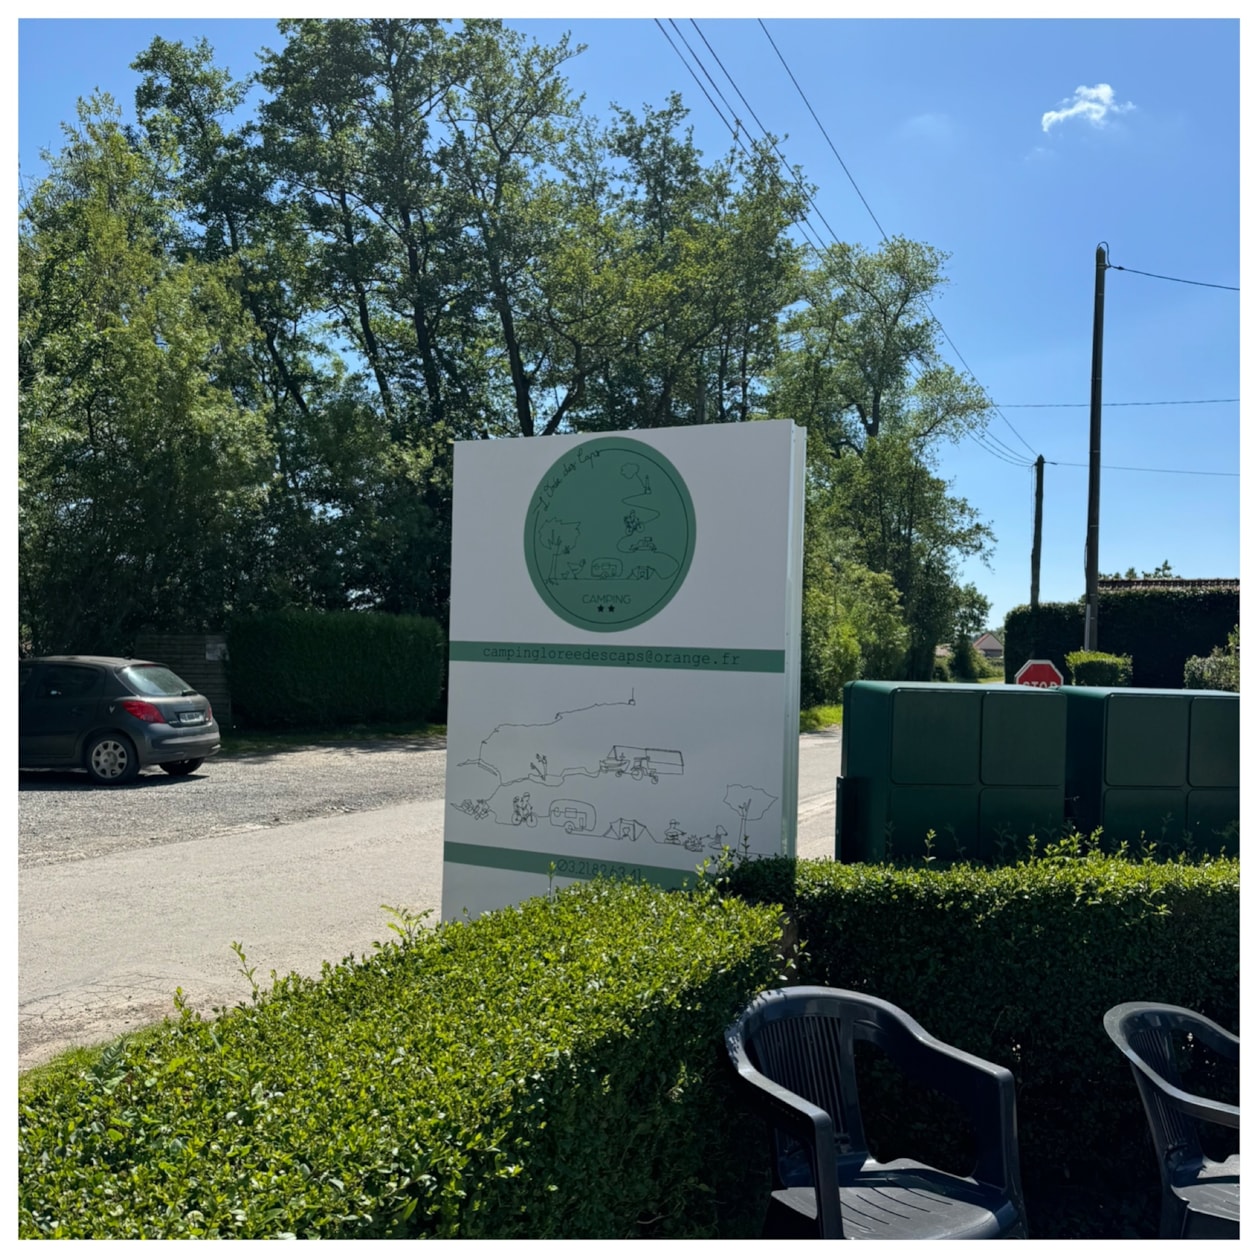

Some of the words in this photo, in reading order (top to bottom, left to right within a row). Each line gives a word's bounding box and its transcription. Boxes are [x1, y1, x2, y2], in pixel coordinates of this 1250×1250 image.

[563, 461, 577, 477] des
[577, 447, 600, 469] Caps
[582, 593, 632, 605] CAMPING
[482, 646, 741, 667] campingloreedescaps@orange.fr
